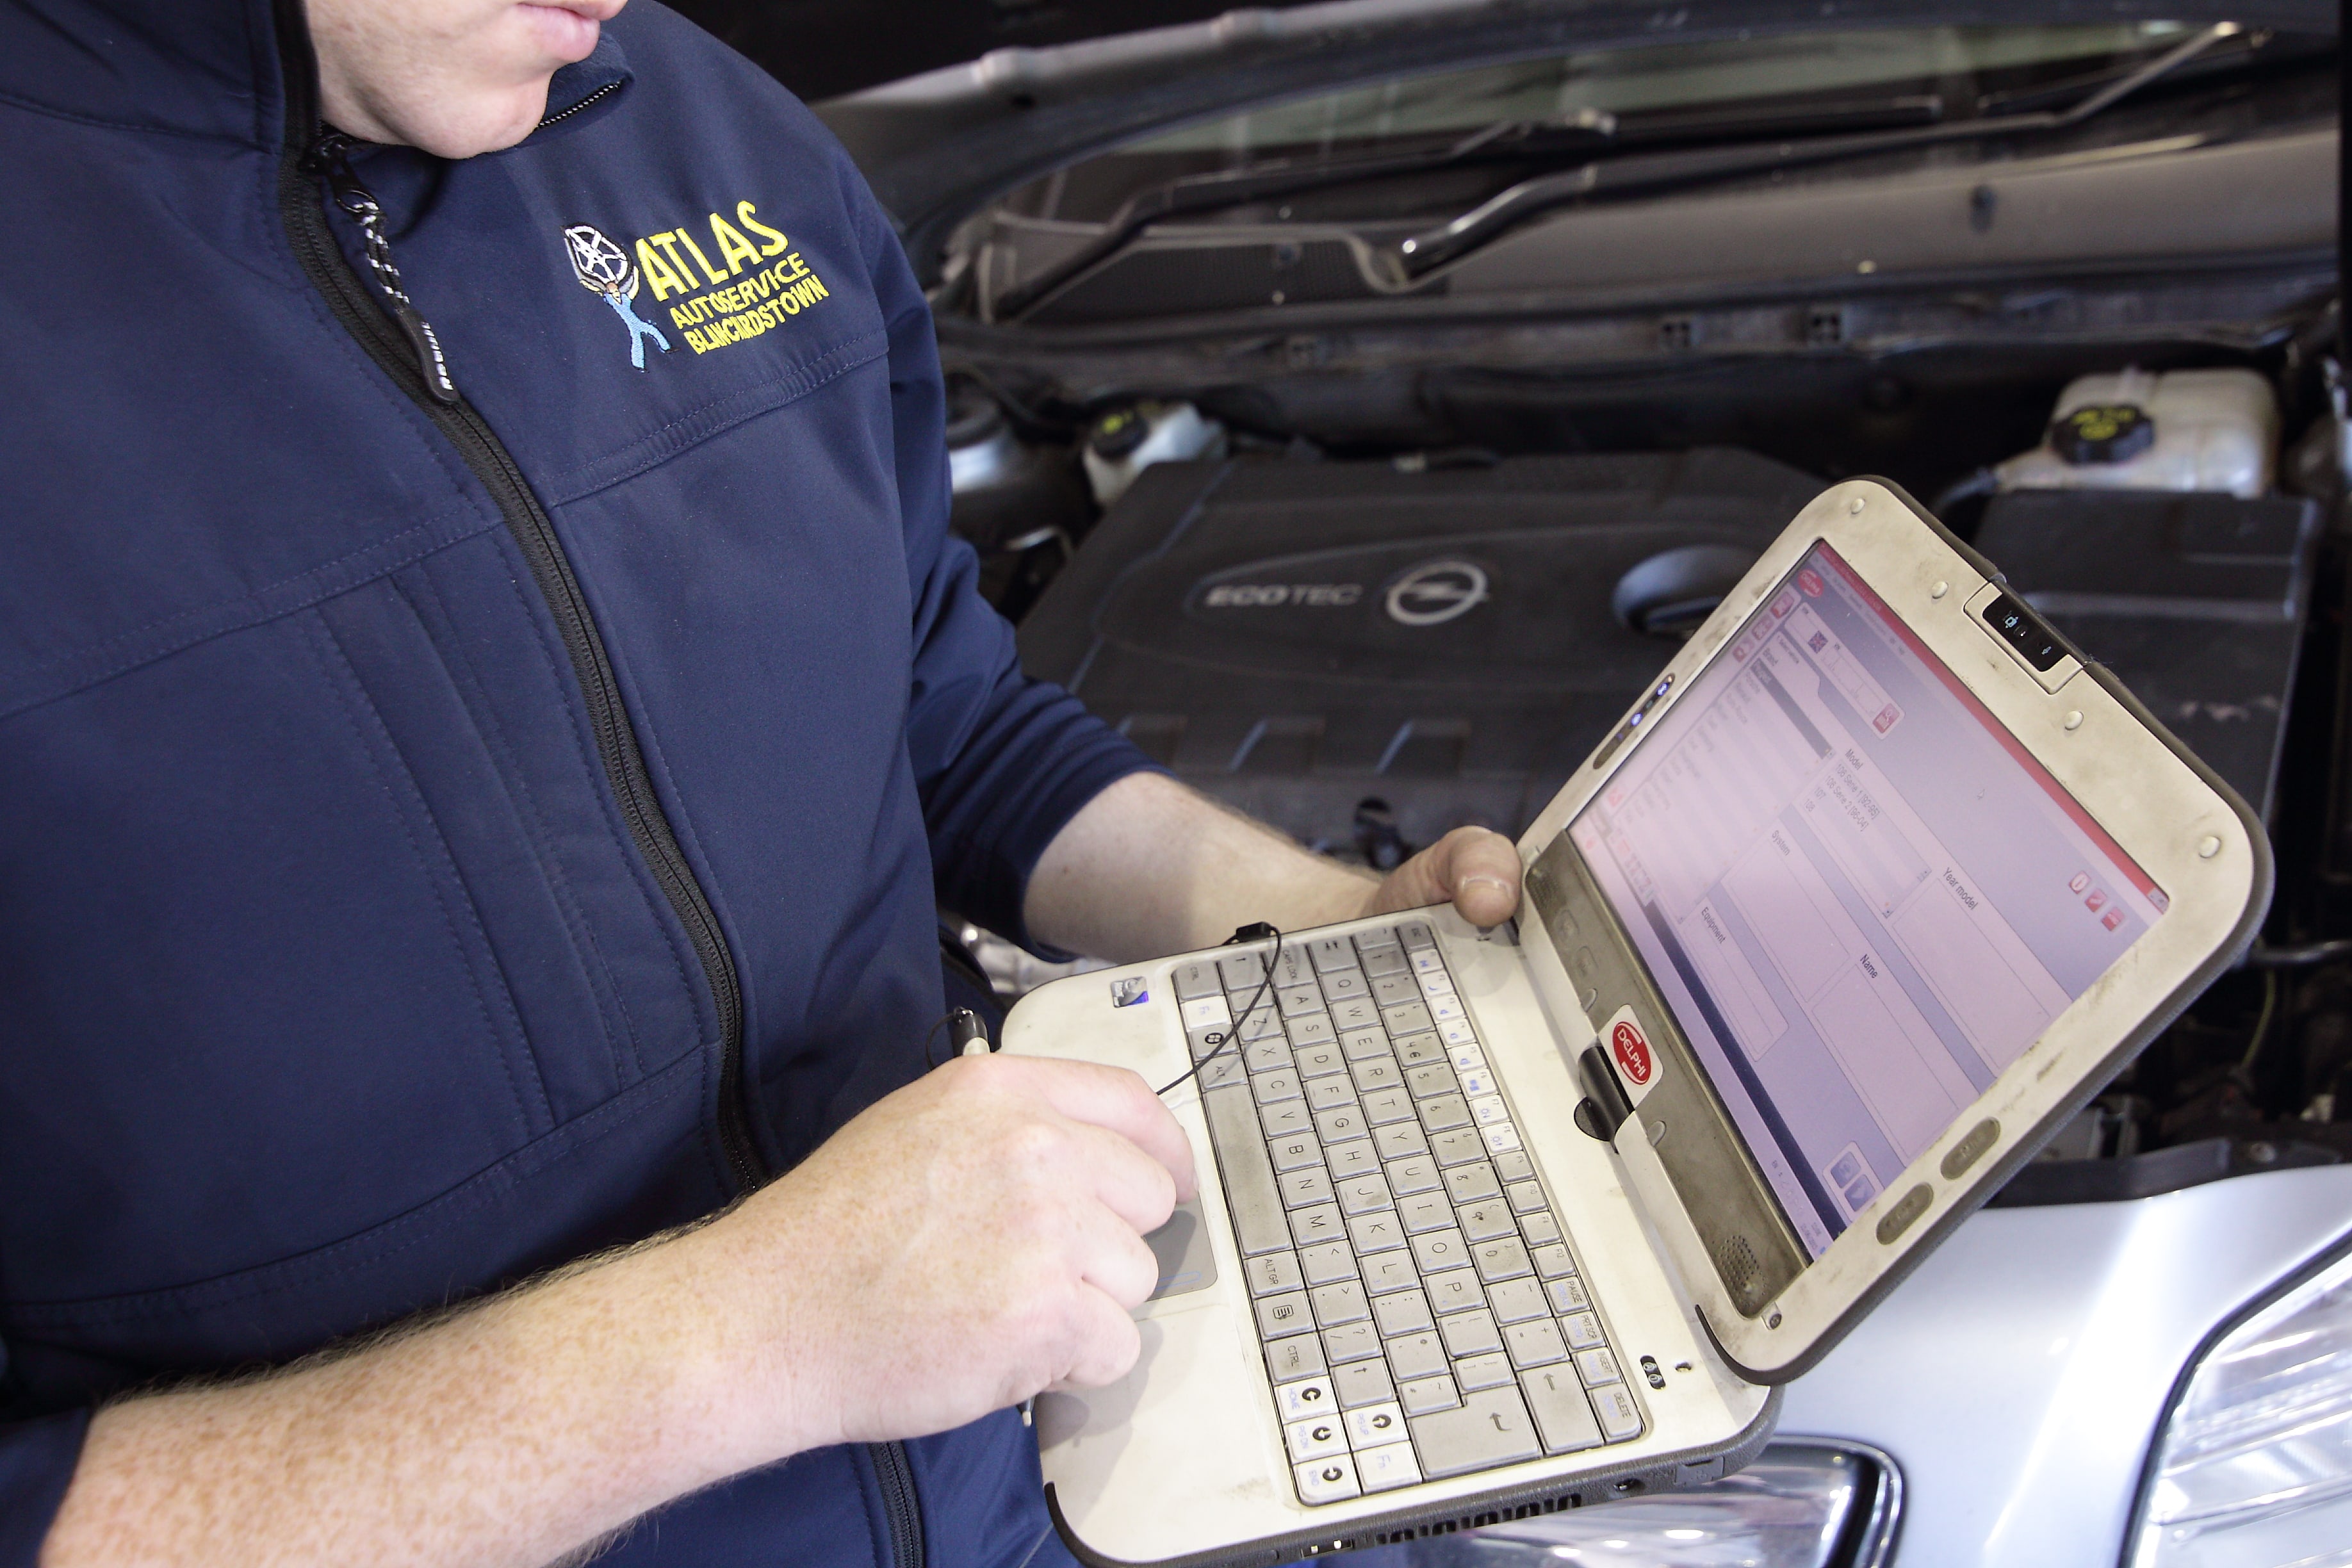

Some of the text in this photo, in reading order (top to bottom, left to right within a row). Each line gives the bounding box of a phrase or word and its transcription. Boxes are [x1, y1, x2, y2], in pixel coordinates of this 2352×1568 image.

[636, 200, 788, 302] ATLAS
[669, 252, 810, 329] AUTOSERVICE
[1206, 584, 1364, 607] ECOTEC
[1845, 748, 1863, 770] Model
[1835, 763, 1847, 778] 106
[1825, 774, 1836, 789] 106
[1813, 787, 1827, 799] 107
[1771, 829, 1790, 856] System
[1943, 867, 1978, 910] Year model
[1701, 906, 1726, 943] Equipment
[1859, 953, 1878, 979] Name
[1337, 979, 1352, 988] Q
[1295, 996, 1309, 1004] A
[1198, 1005, 1211, 1015] Fn
[1348, 1007, 1363, 1017] W
[1252, 1017, 1268, 1025] Z
[1305, 1024, 1319, 1032] S
[1357, 1036, 1373, 1046] E
[1261, 1047, 1276, 1056] X
[1617, 1028, 1647, 1077] DELPHI
[1313, 1054, 1328, 1063] D
[1216, 1066, 1225, 1077] ALT
[1369, 1067, 1384, 1076] R
[1270, 1079, 1285, 1089] C
[1380, 1098, 1396, 1106] T
[1334, 1117, 1350, 1128] G
[1392, 1131, 1408, 1139] Y
[1288, 1144, 1304, 1154] B
[1345, 1150, 1361, 1161] H
[1404, 1166, 1421, 1176] U
[1298, 1179, 1314, 1189] N
[1309, 1214, 1326, 1228] M
[1368, 1222, 1385, 1234] K
[1431, 1241, 1448, 1254] O
[1264, 1258, 1278, 1284] ALT GR
[1381, 1262, 1396, 1274] L
[1444, 1281, 1462, 1292] P
[1567, 1280, 1583, 1303] PAUSE
[1582, 1314, 1597, 1339] PRT SCR
[1287, 1345, 1299, 1367] CTRL
[1596, 1350, 1613, 1375] INSERT
[1286, 1387, 1300, 1410] HOME
[1613, 1392, 1631, 1417] DELETE
[1375, 1453, 1392, 1469] Fn
